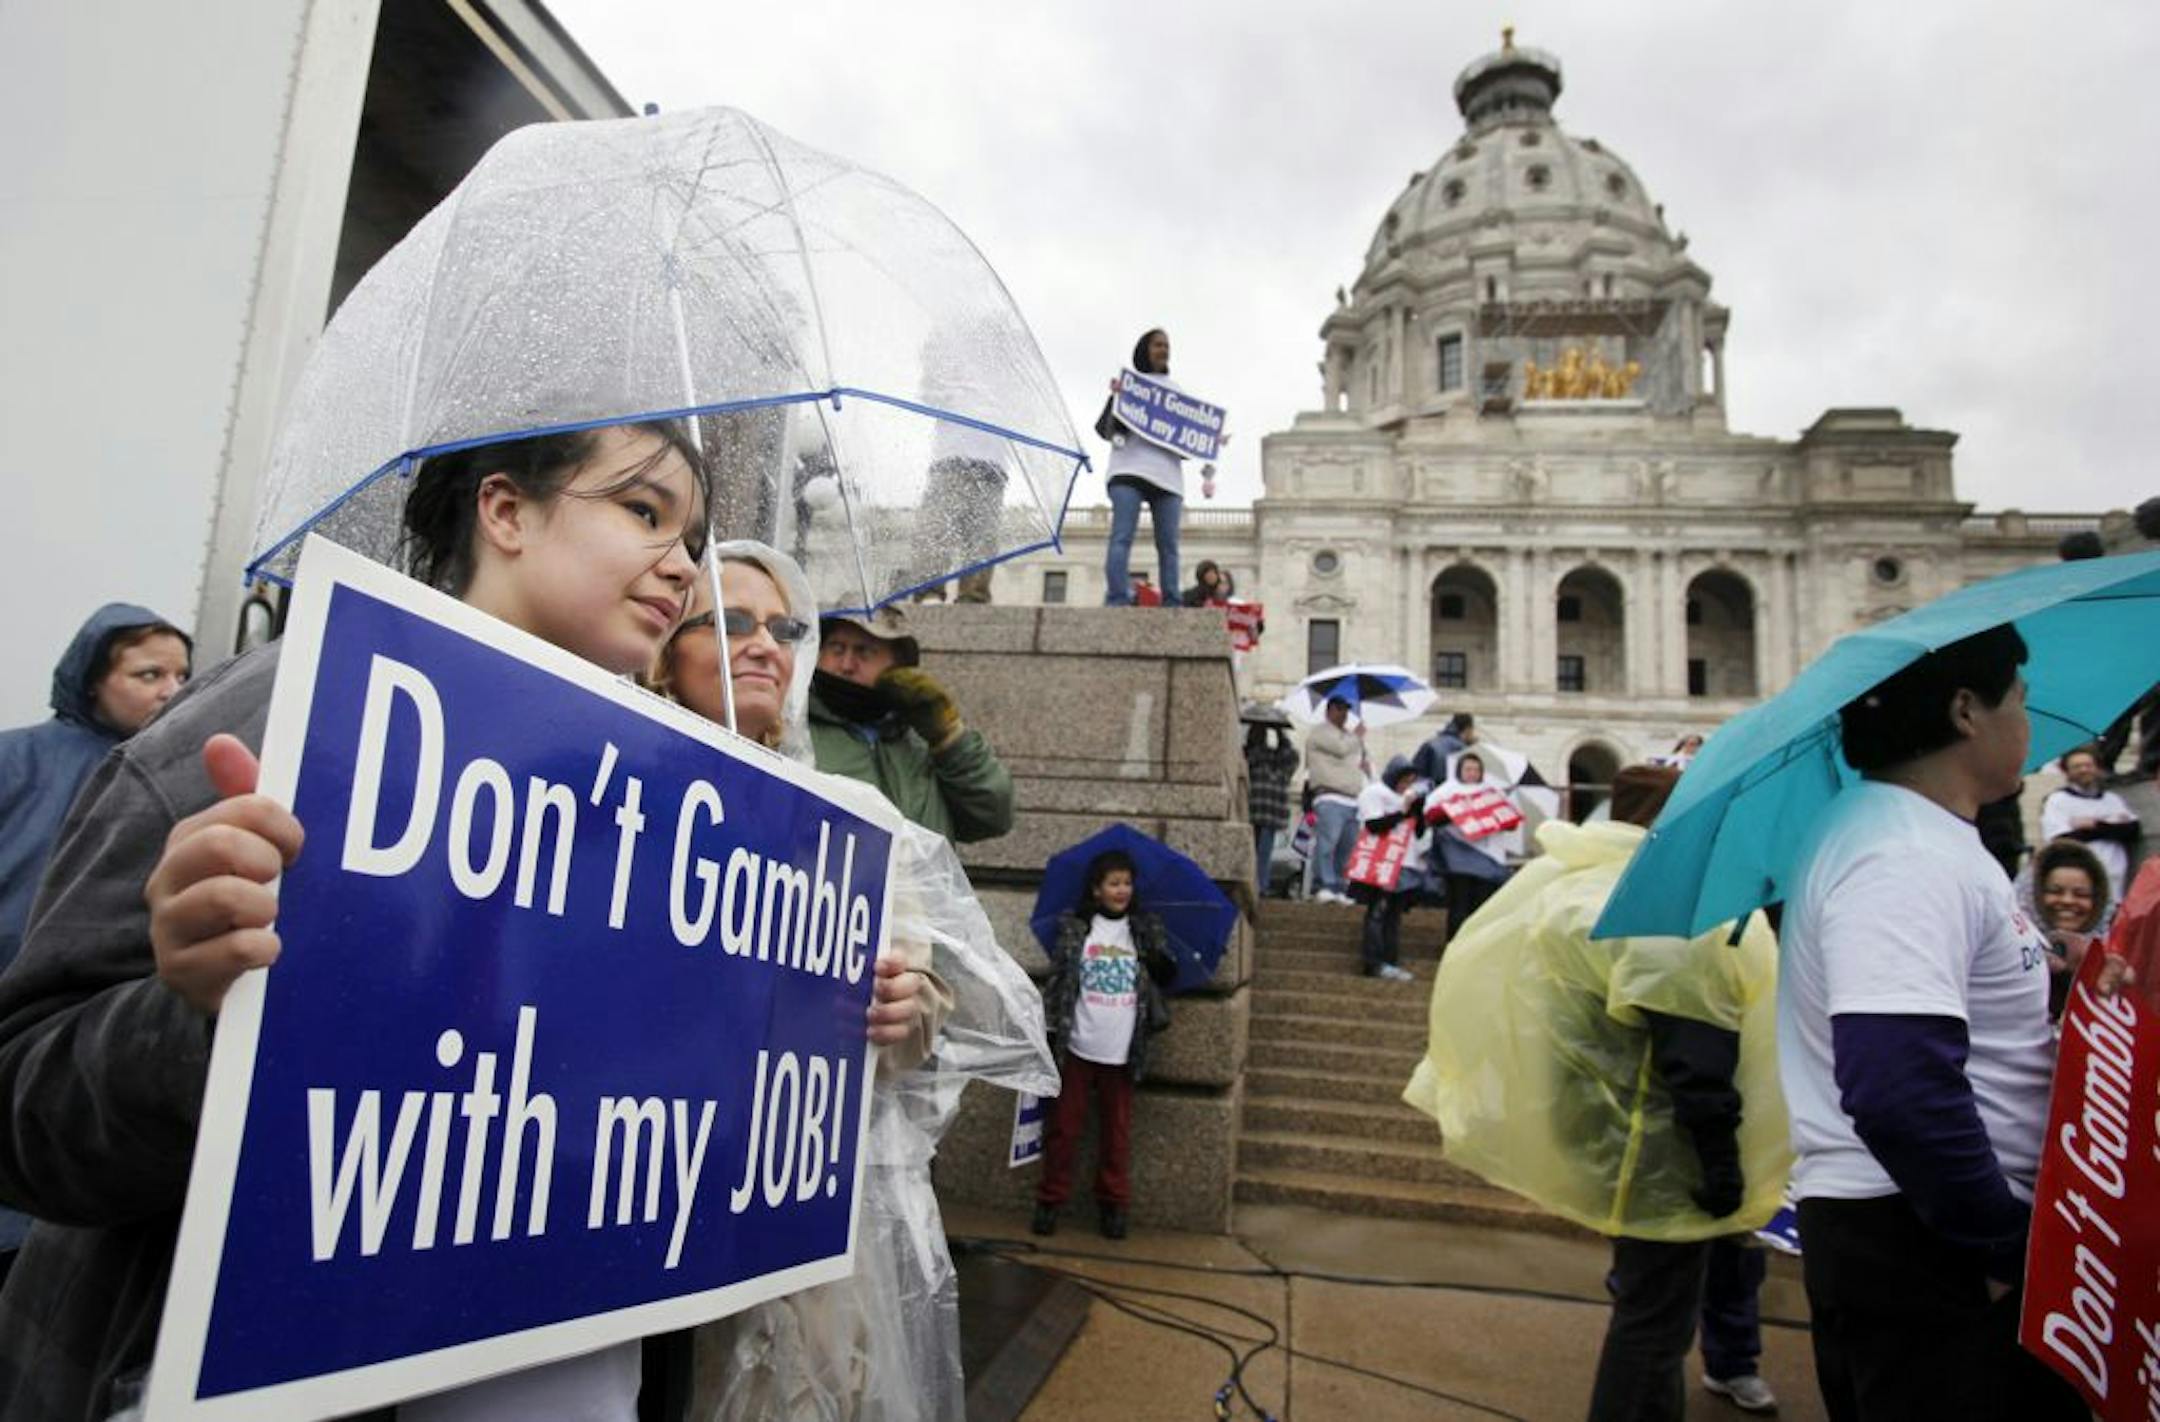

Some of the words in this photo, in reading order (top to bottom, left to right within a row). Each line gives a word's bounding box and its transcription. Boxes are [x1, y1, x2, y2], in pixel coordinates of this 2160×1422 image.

[1120, 401, 1148, 427] with
[1151, 418, 1176, 442] my
[1178, 426, 1215, 456] JOB!
[1123, 373, 1162, 406] Don't
[1164, 393, 1220, 430] Gamble
[341, 653, 645, 930] Don't
[669, 779, 871, 985] Gamble
[307, 1005, 557, 1262] with
[587, 1096, 718, 1269] my
[730, 1049, 847, 1214] JOB!
[2060, 981, 2138, 1199] Gamble
[2043, 1188, 2122, 1400] Don't
